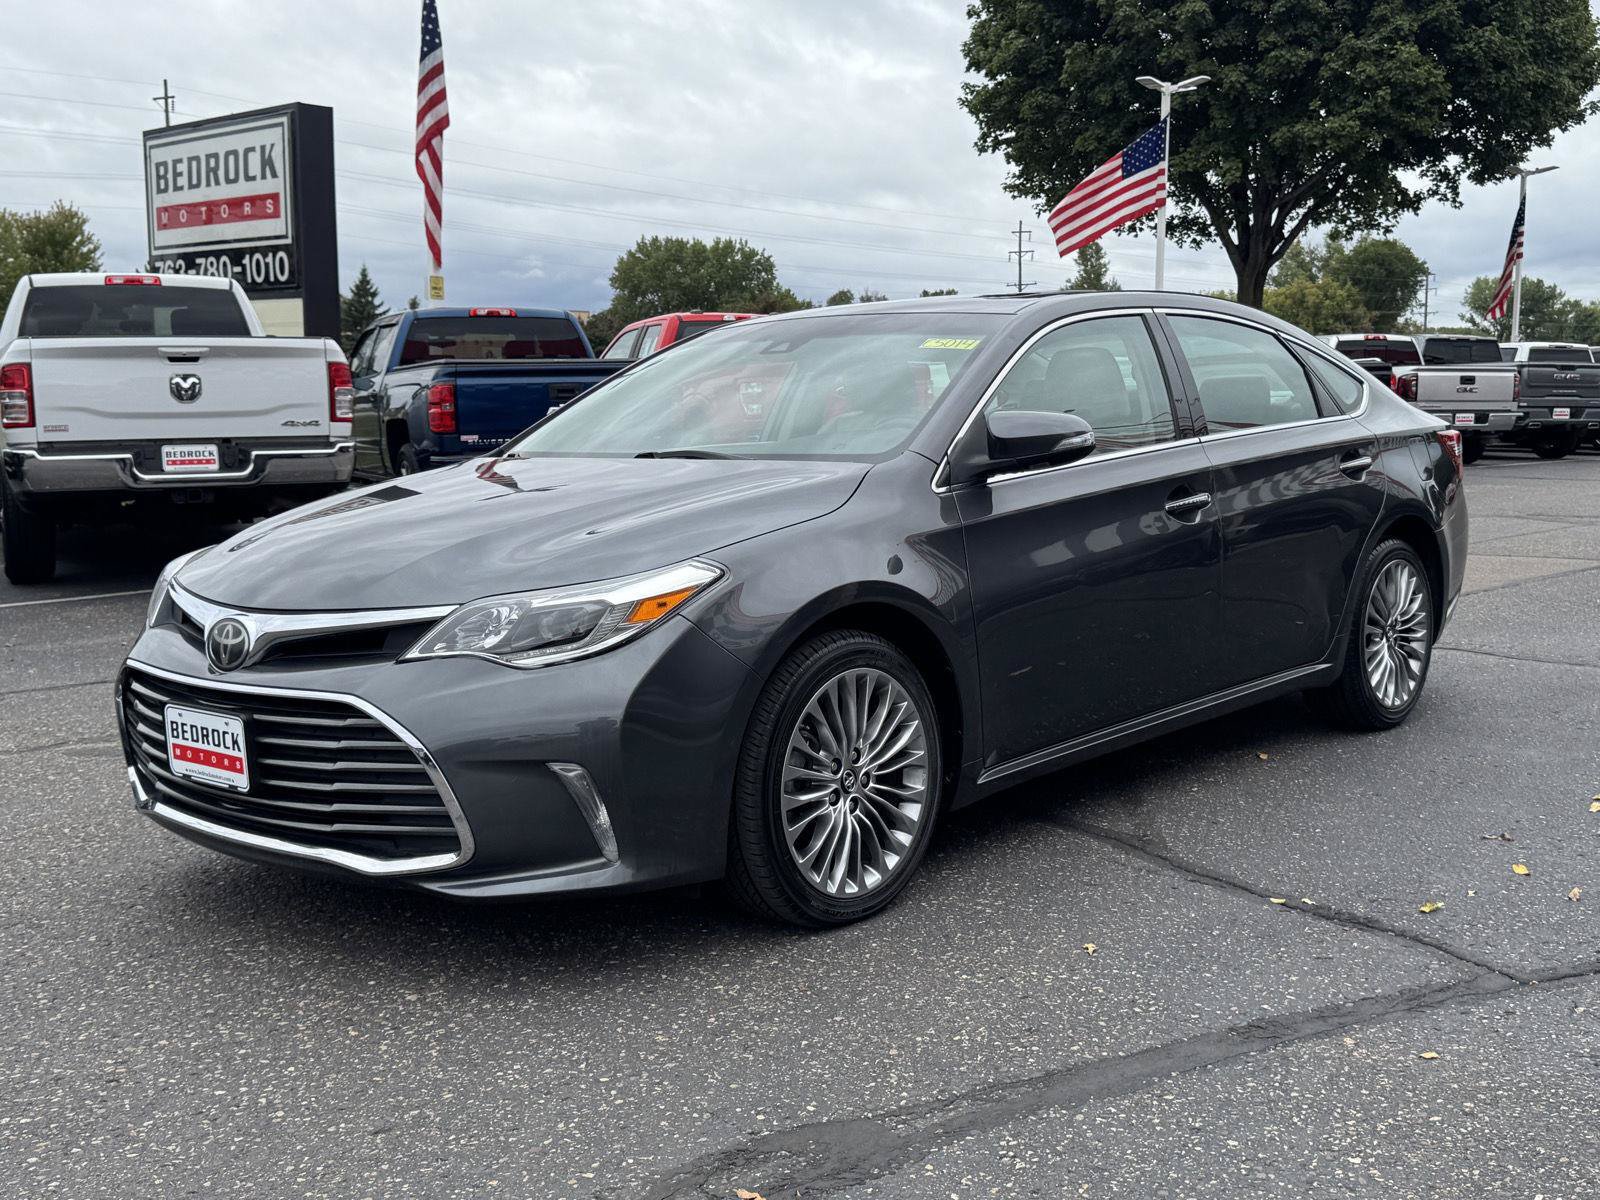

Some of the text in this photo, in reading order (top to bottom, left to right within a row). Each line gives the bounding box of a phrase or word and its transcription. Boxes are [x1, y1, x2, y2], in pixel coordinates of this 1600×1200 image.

[155, 143, 279, 195] BEDROCK
[161, 199, 274, 224] MOTORS
[165, 450, 215, 458] BEDROCK
[170, 721, 242, 753] BEDROCK
[175, 747, 241, 769] MOTORS
